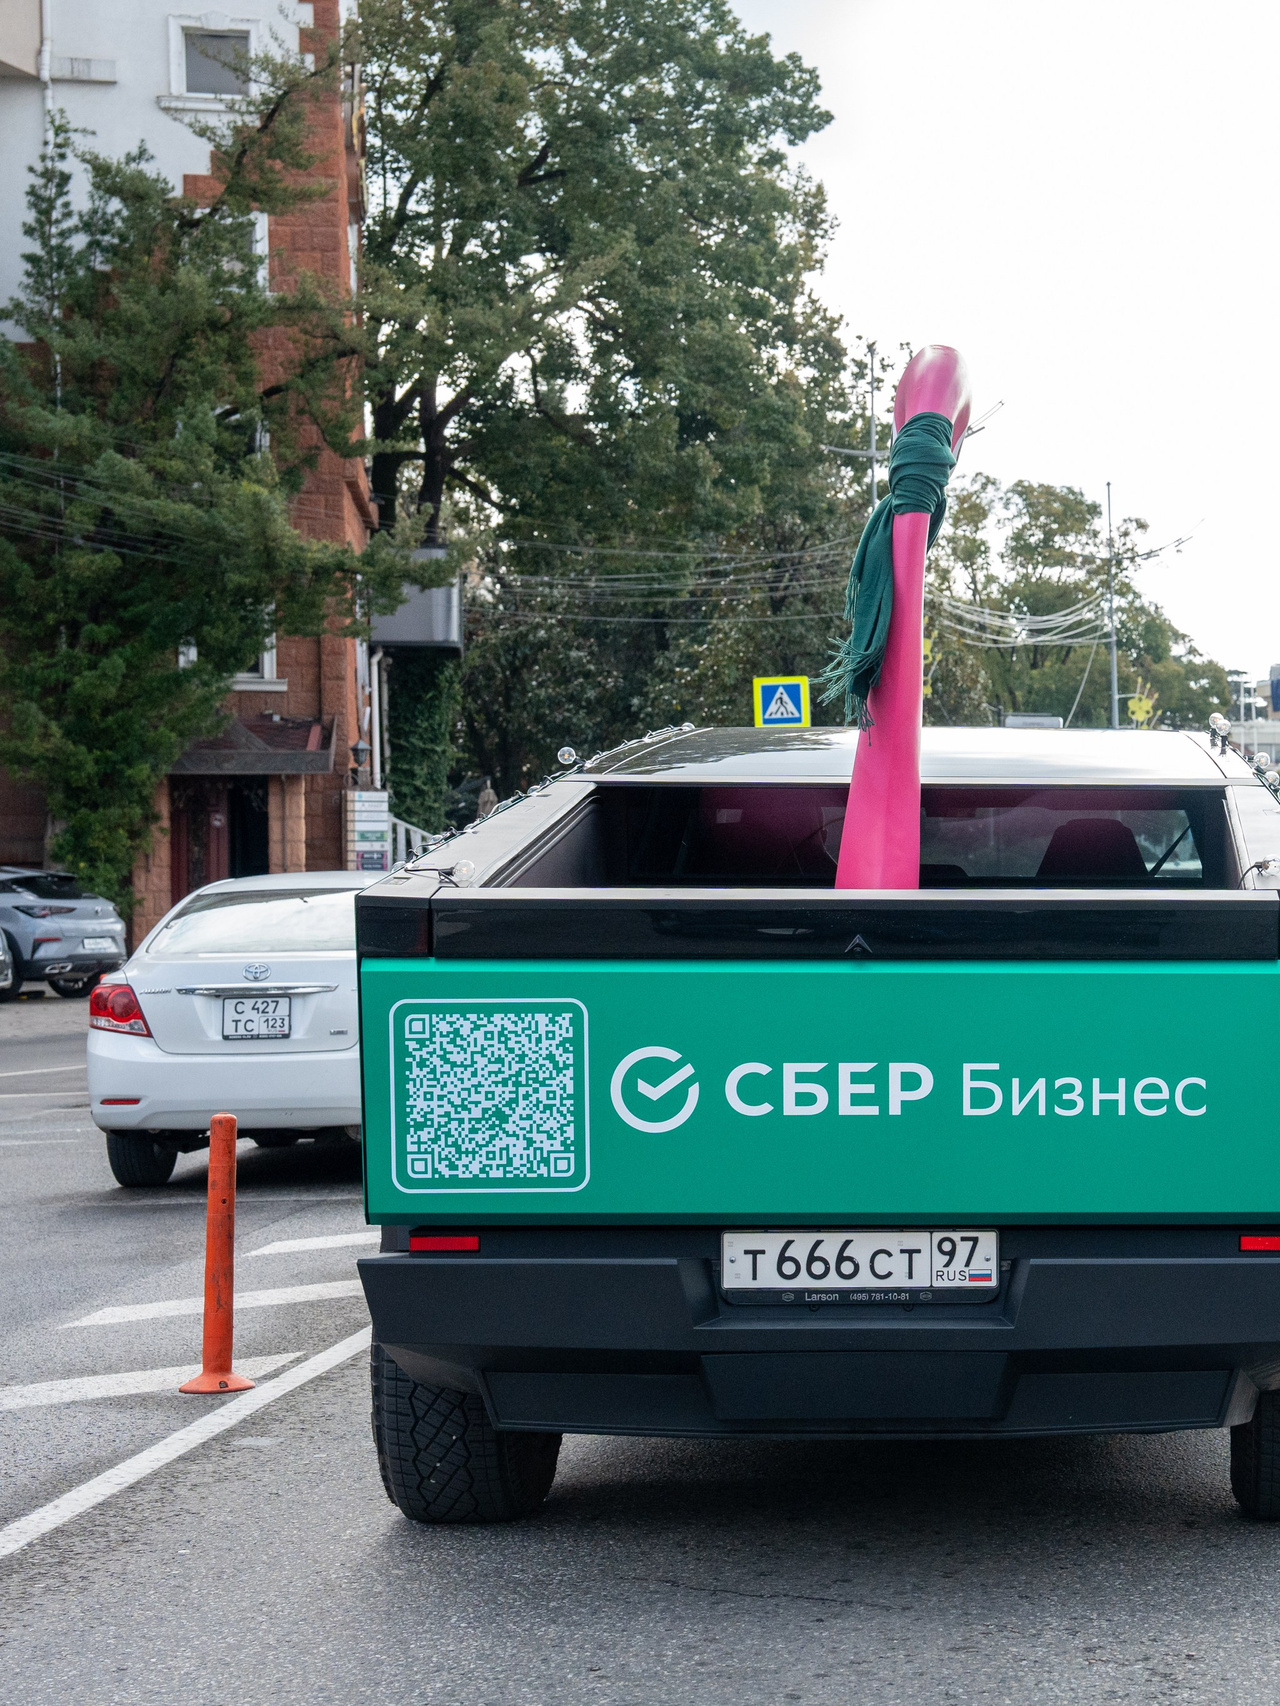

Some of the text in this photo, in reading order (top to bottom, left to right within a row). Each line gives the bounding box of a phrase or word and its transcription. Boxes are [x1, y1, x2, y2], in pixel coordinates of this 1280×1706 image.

[251, 1000, 280, 1015] 427
[231, 1018, 255, 1034] ТС
[263, 1017, 286, 1029] 123
[724, 1061, 1208, 1118] СБЕР Бизнес
[936, 1236, 980, 1268] 97
[935, 1270, 968, 1282] RUS
[804, 1292, 840, 1301] Larson
[849, 1292, 869, 1301] (495)
